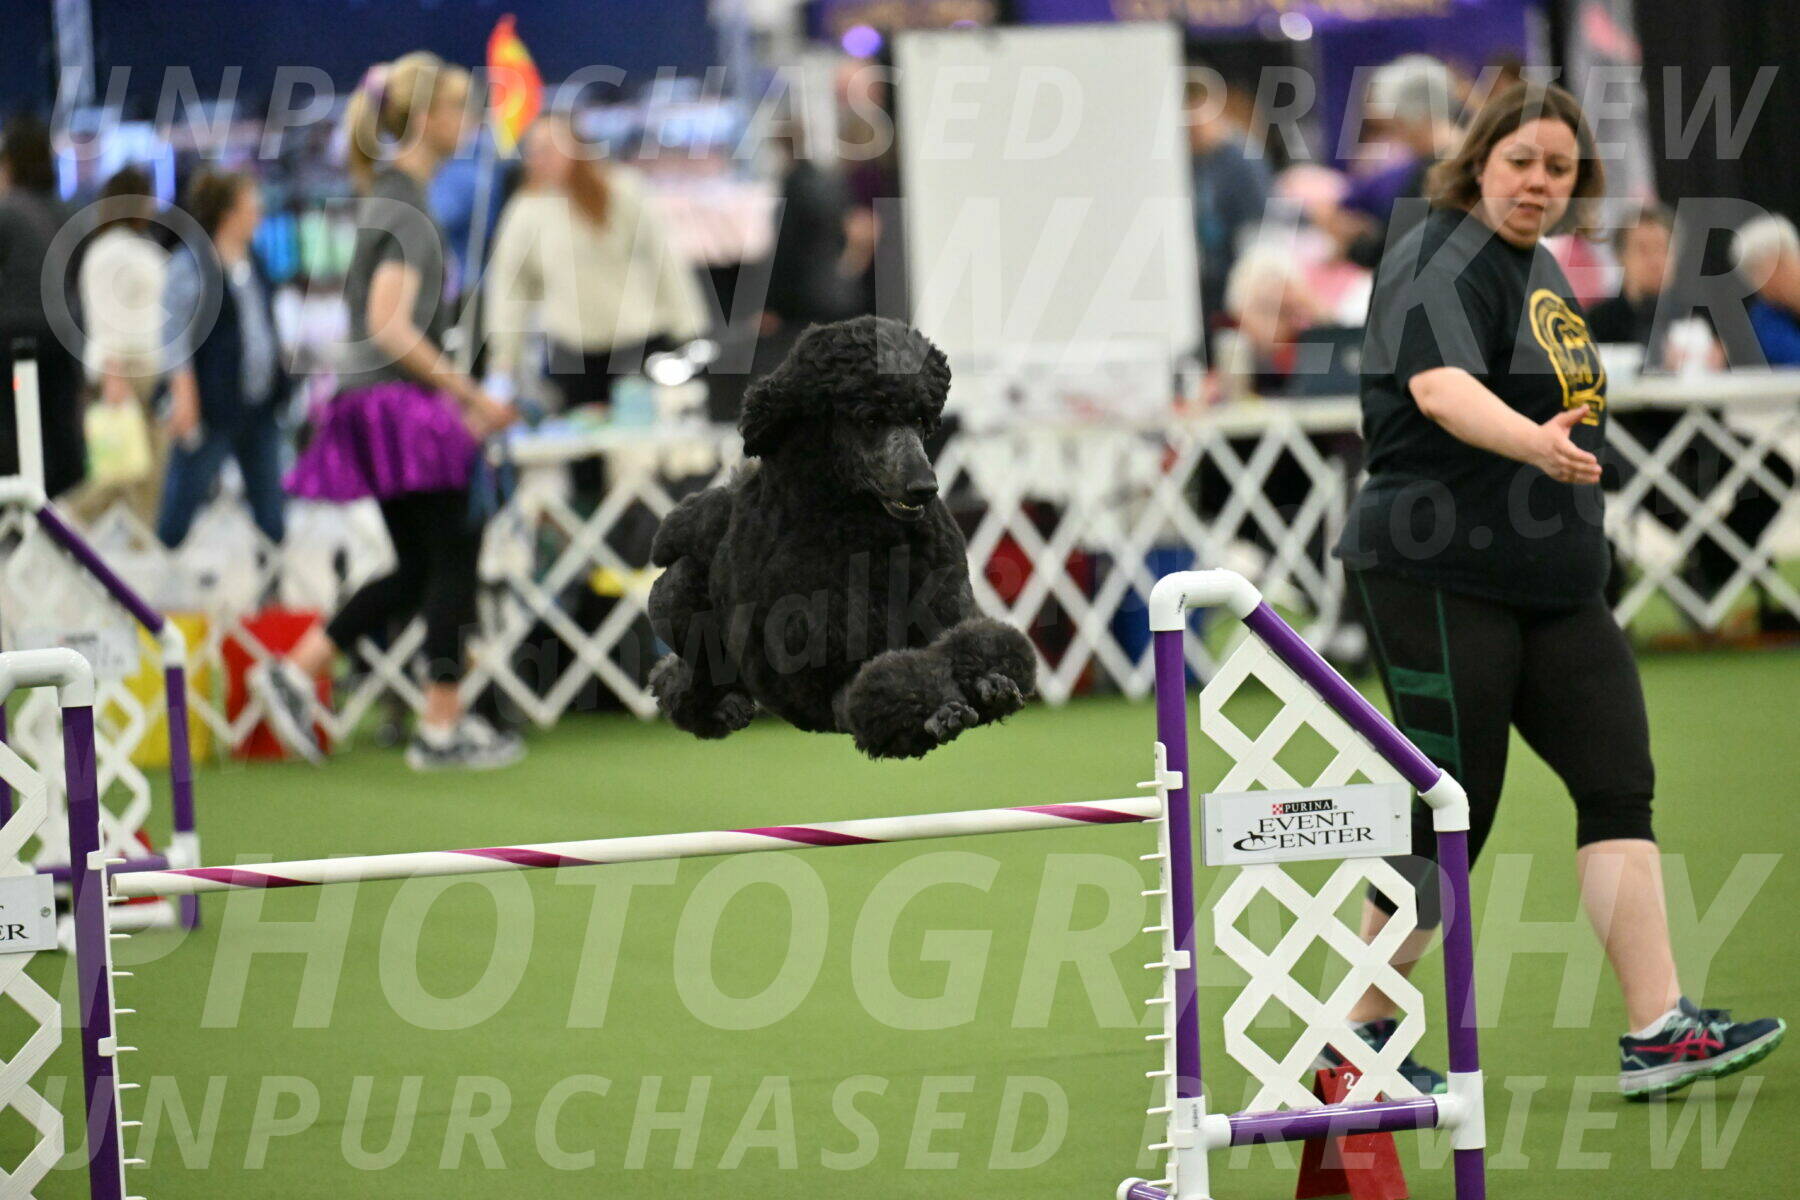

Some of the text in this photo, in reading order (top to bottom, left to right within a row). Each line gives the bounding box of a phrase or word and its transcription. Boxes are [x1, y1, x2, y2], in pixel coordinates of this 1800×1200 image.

[1284, 799, 1332, 813] PURINA
[1259, 811, 1354, 833] EVENT
[1233, 827, 1375, 851] CENTER
[1343, 1072, 1355, 1090] 2
